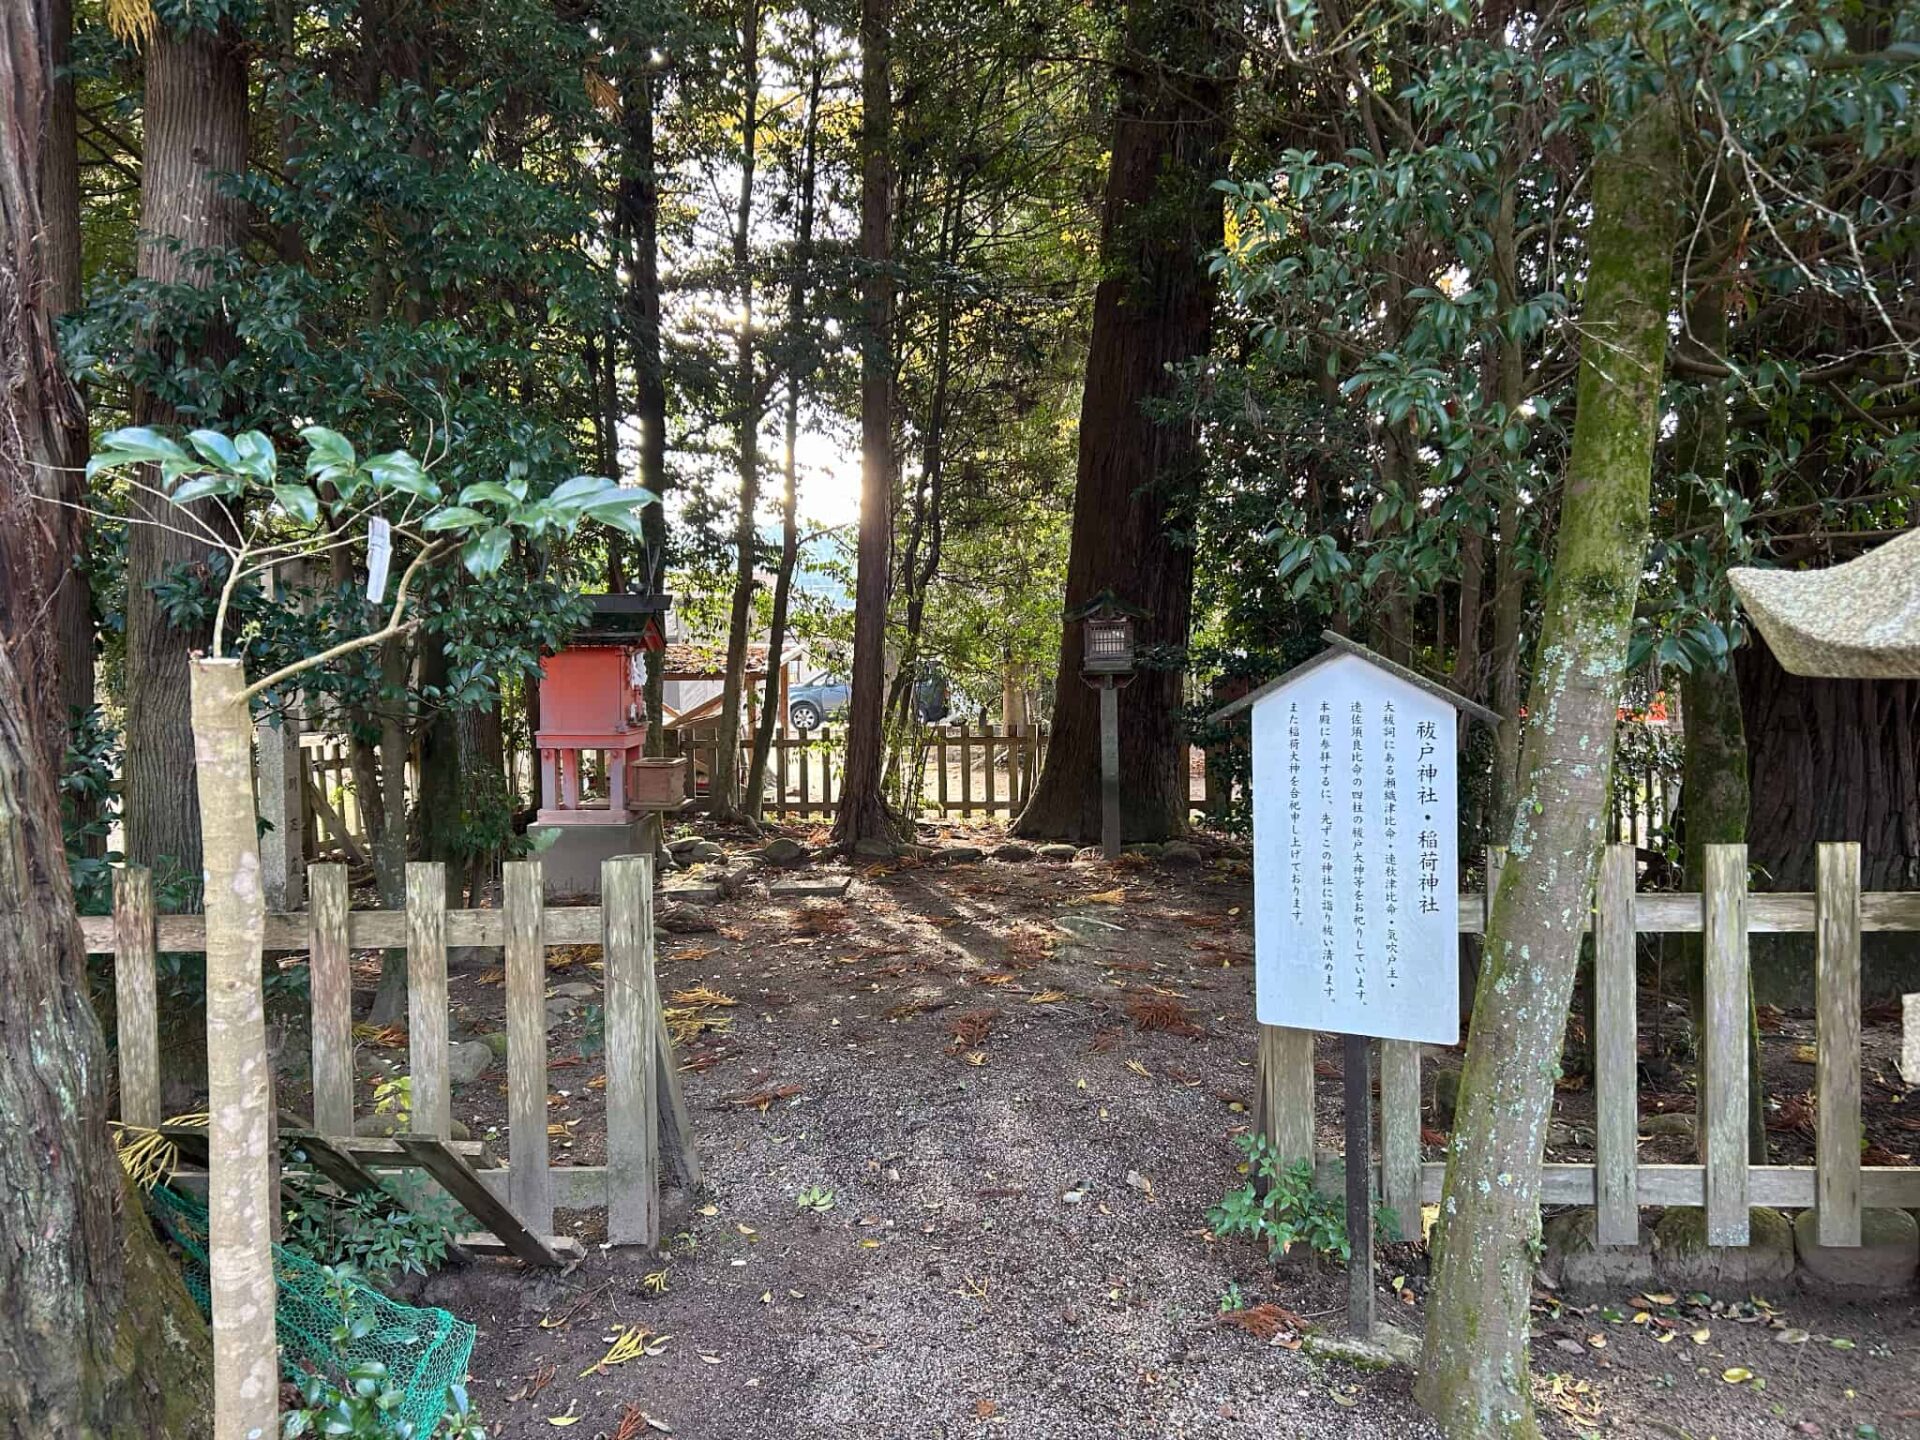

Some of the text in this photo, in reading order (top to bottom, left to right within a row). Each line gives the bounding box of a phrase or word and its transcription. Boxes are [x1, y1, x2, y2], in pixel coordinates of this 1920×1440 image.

[1416, 720, 1440, 914] 祓戸神社・稲荷神社
